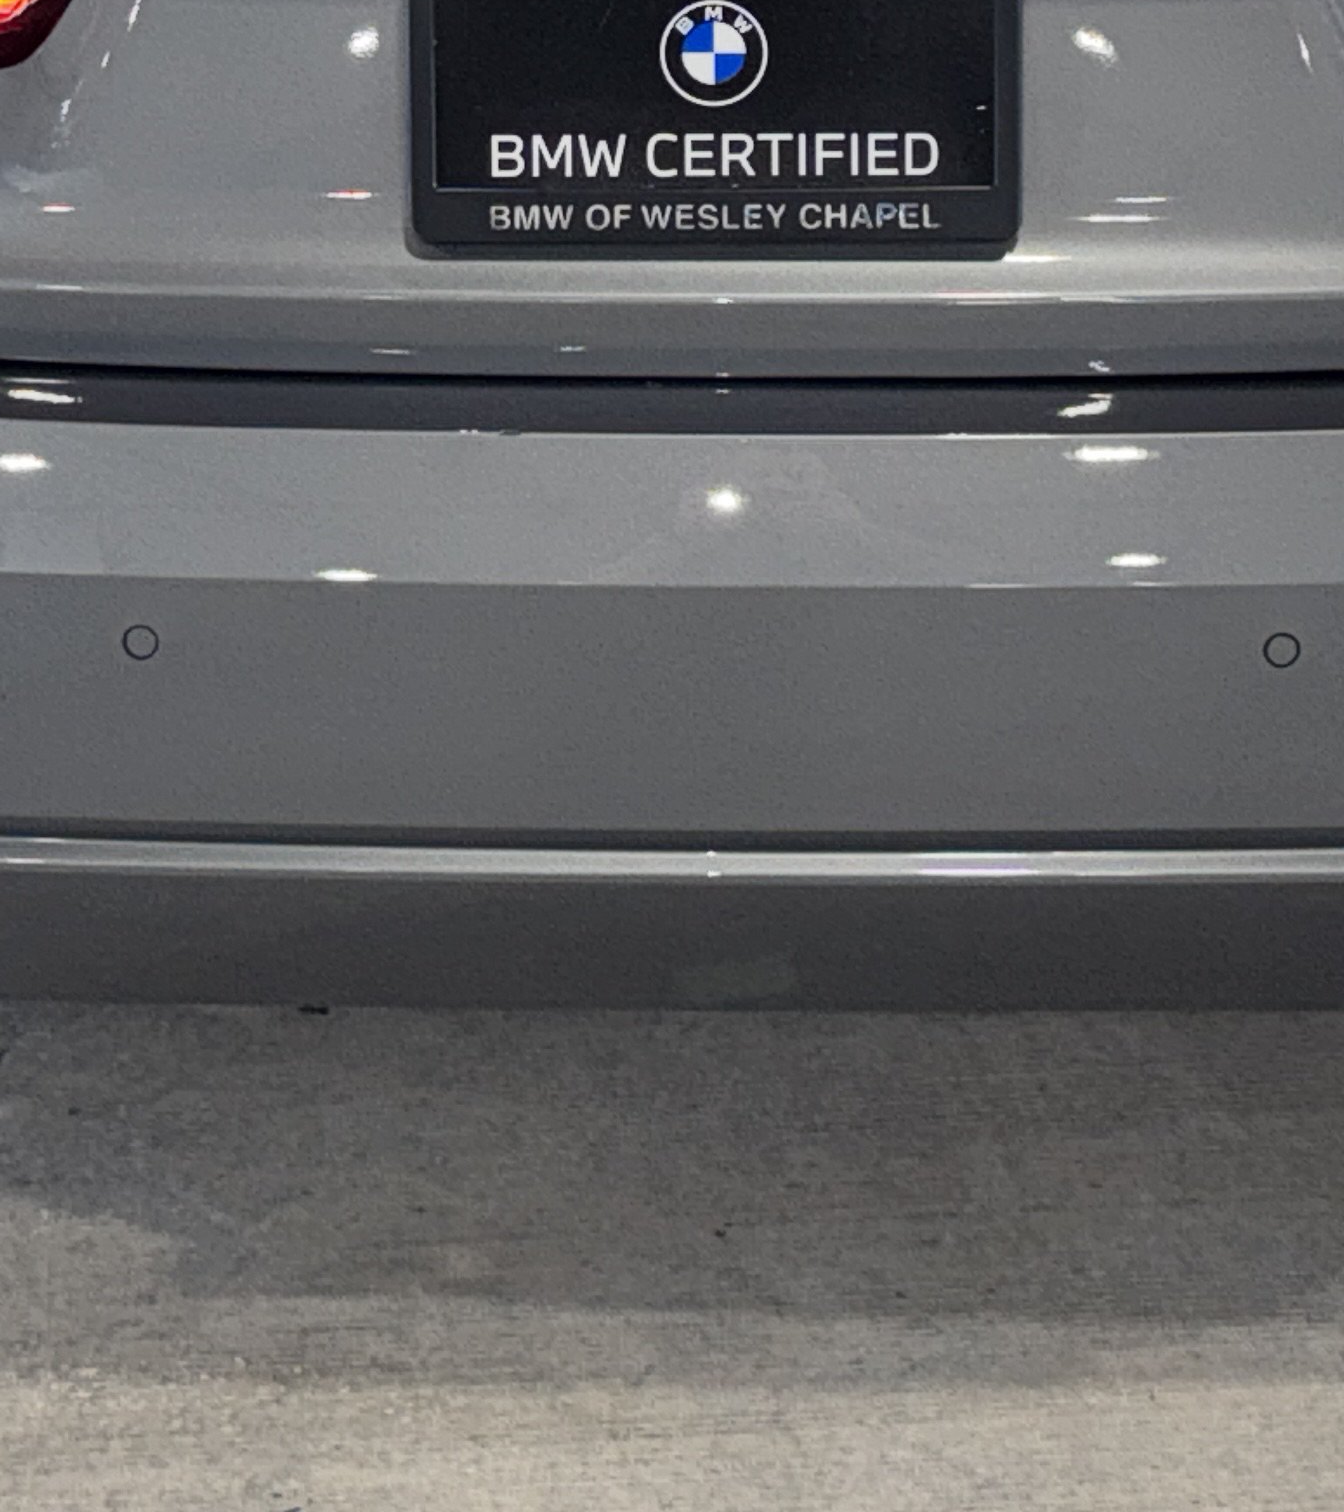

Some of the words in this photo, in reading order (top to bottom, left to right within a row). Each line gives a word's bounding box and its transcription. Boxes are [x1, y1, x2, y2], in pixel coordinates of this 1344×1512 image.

[674, 4, 754, 37] BMW
[489, 133, 627, 179] BMW
[646, 131, 940, 178] CERTIFIED
[489, 204, 574, 231] BMW
[585, 204, 633, 230] OF
[641, 203, 787, 230] WESLEY
[798, 202, 942, 230] CHAPEL
